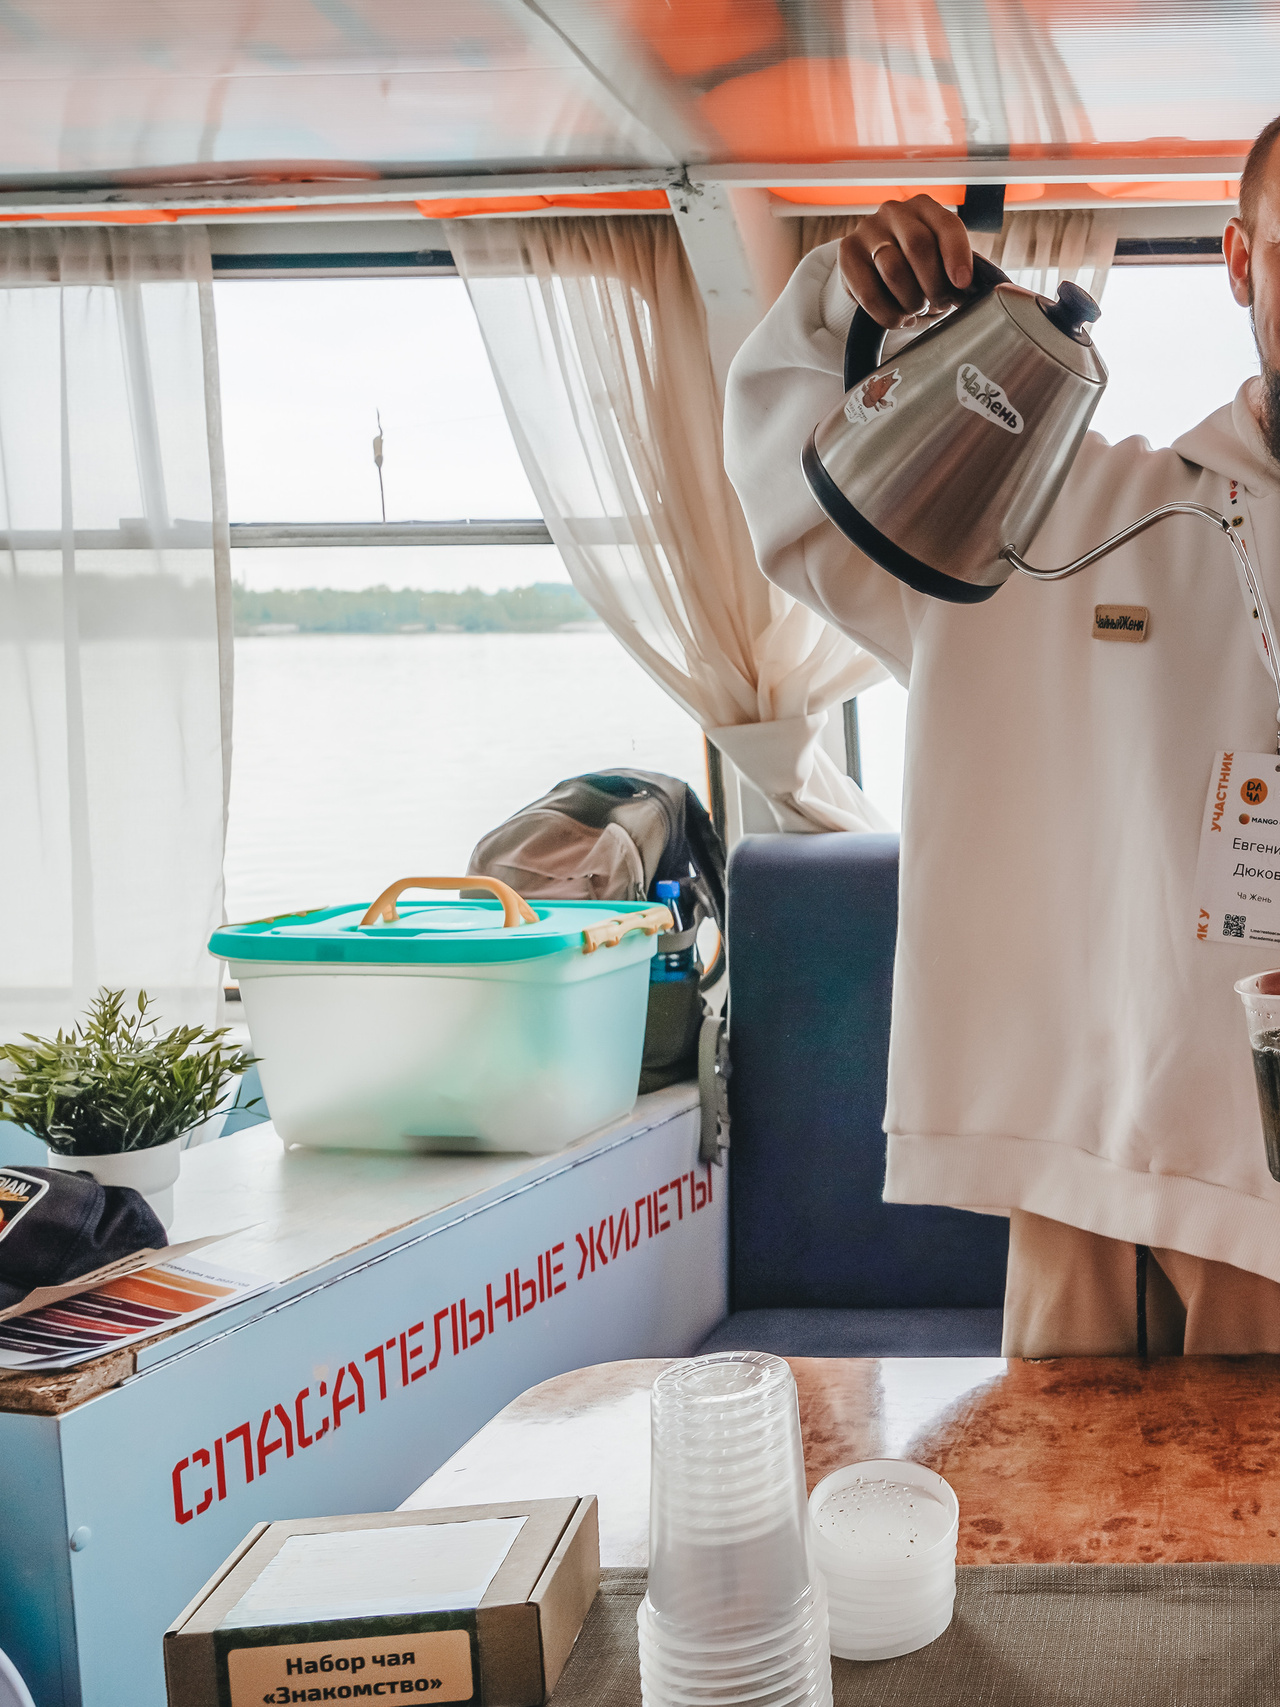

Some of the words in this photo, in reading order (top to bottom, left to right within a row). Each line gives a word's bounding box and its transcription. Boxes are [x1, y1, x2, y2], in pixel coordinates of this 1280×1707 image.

[1211, 752, 1234, 832] УЧАСТНИК
[1251, 816, 1279, 825] MANGO
[1236, 891, 1247, 900] Ча
[1249, 893, 1272, 904] Жень
[171, 1241, 567, 1526] СПАСАТЕЛЬНЫЕ
[577, 1158, 713, 1280] ЖИЛЕТЫ
[286, 1654, 365, 1676] Набор
[371, 1651, 415, 1667] чая
[262, 1678, 443, 1705] «Знакомство»
